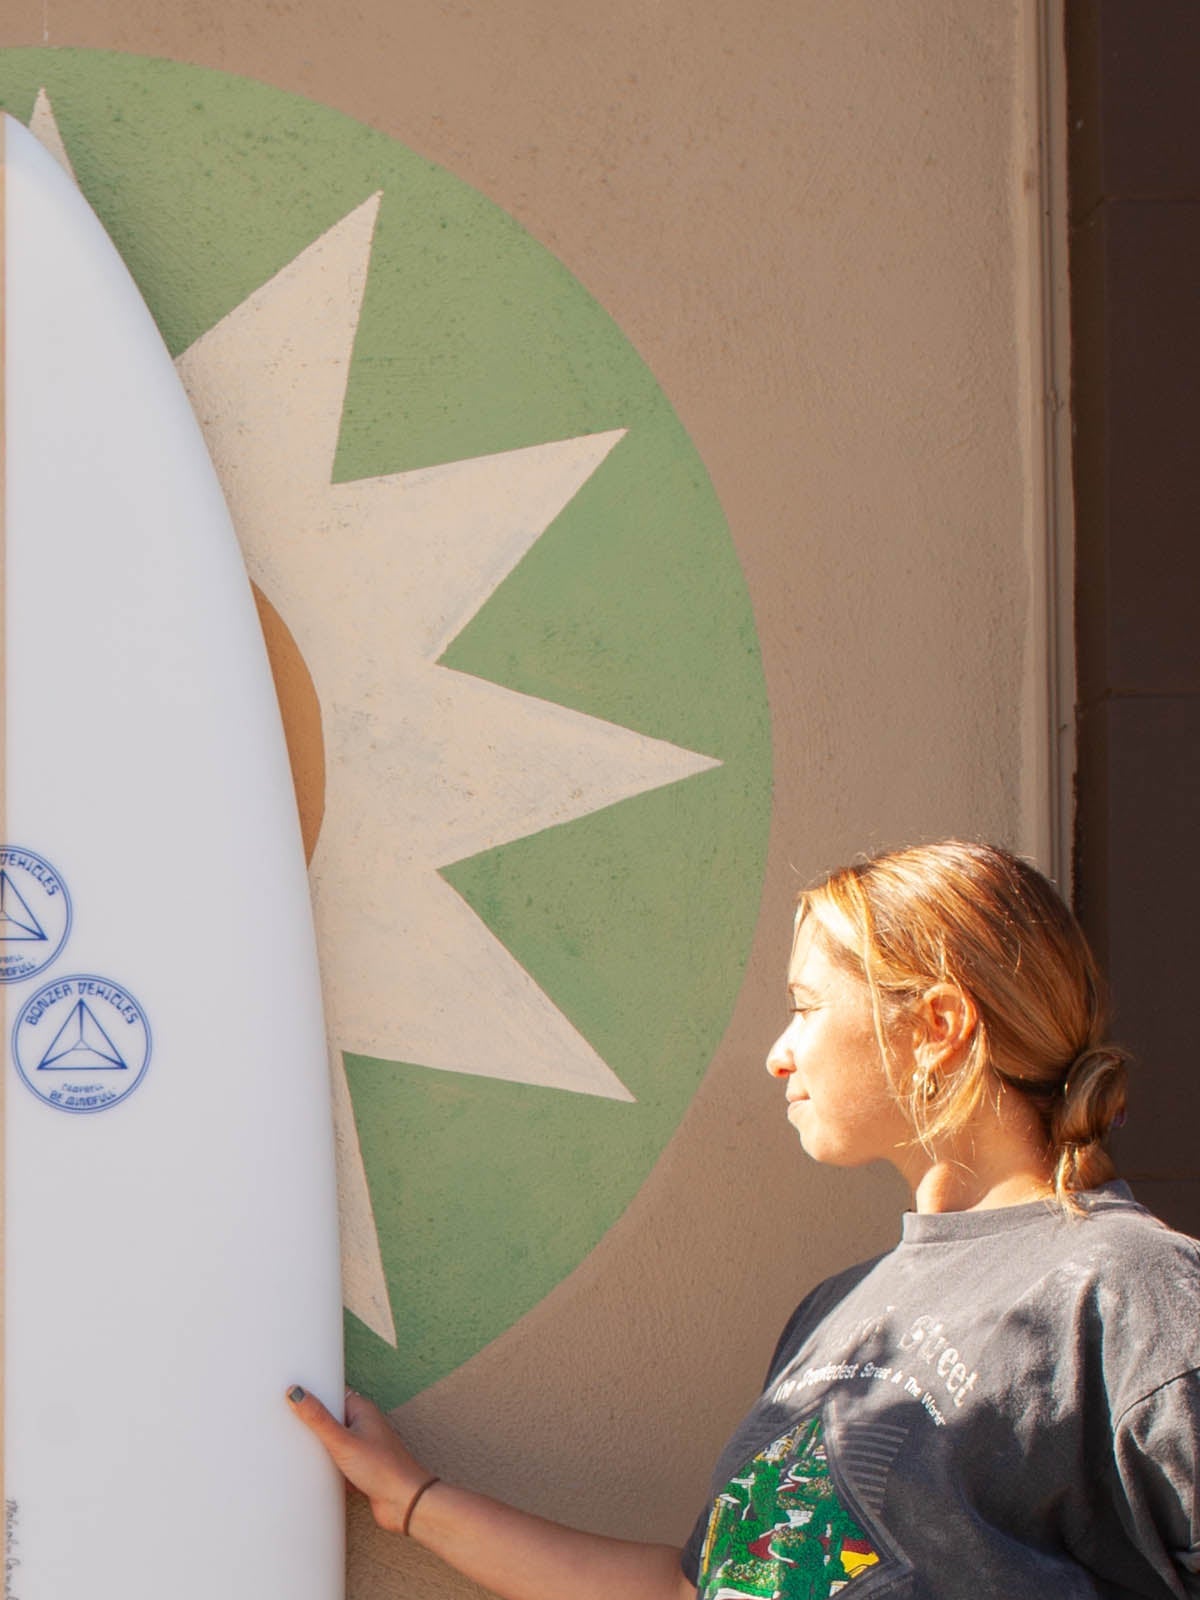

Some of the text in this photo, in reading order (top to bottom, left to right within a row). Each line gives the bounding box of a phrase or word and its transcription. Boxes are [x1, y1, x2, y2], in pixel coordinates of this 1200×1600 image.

[0, 853, 60, 896] VEHICLES
[25, 982, 139, 1026] BONZER VEHICLES
